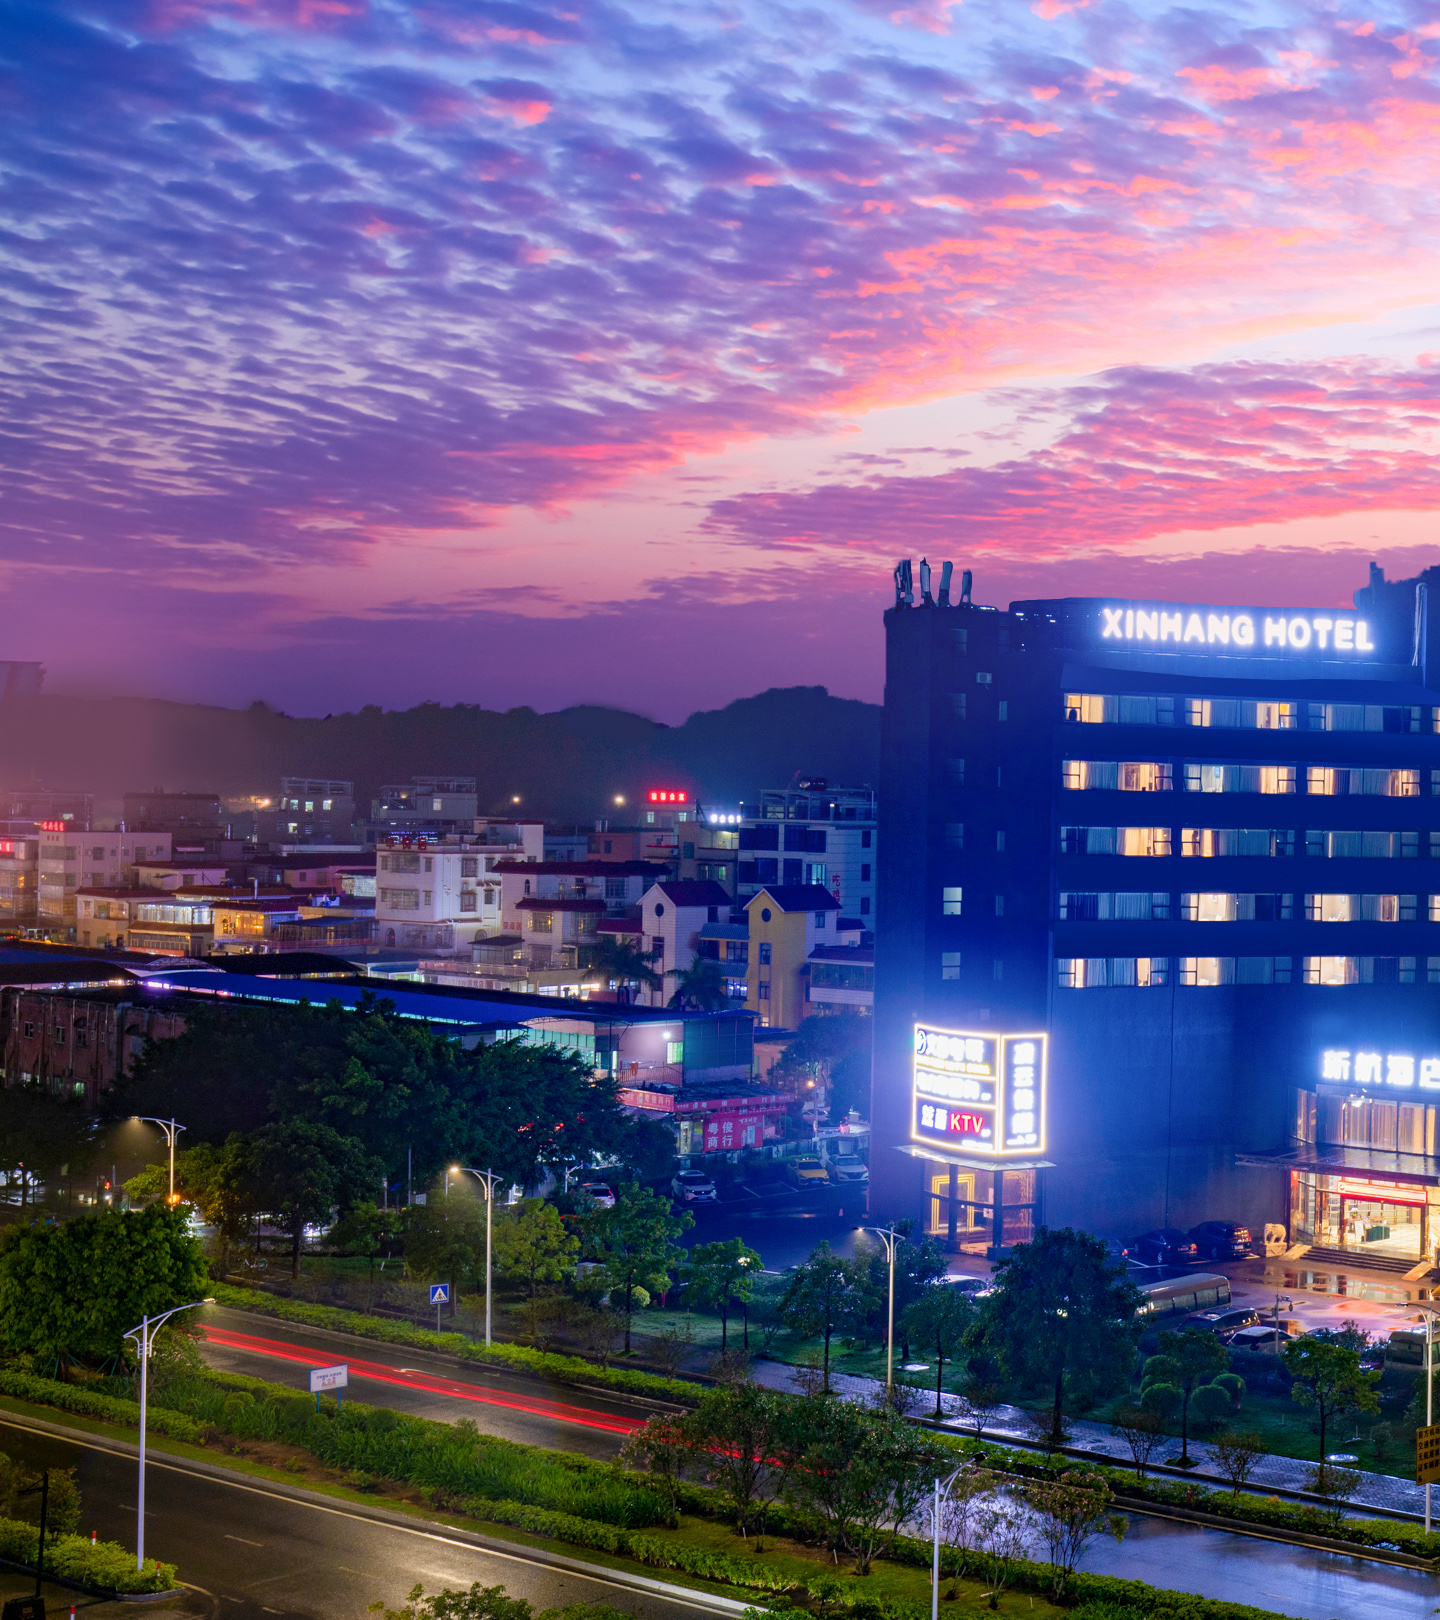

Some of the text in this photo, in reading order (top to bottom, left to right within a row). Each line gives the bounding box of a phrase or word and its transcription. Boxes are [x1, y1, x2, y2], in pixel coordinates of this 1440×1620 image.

[1102, 607, 1373, 650] XINHANG HOTEL
[950, 1112, 984, 1134] KTV
[708, 1135, 733, 1148] 商行
